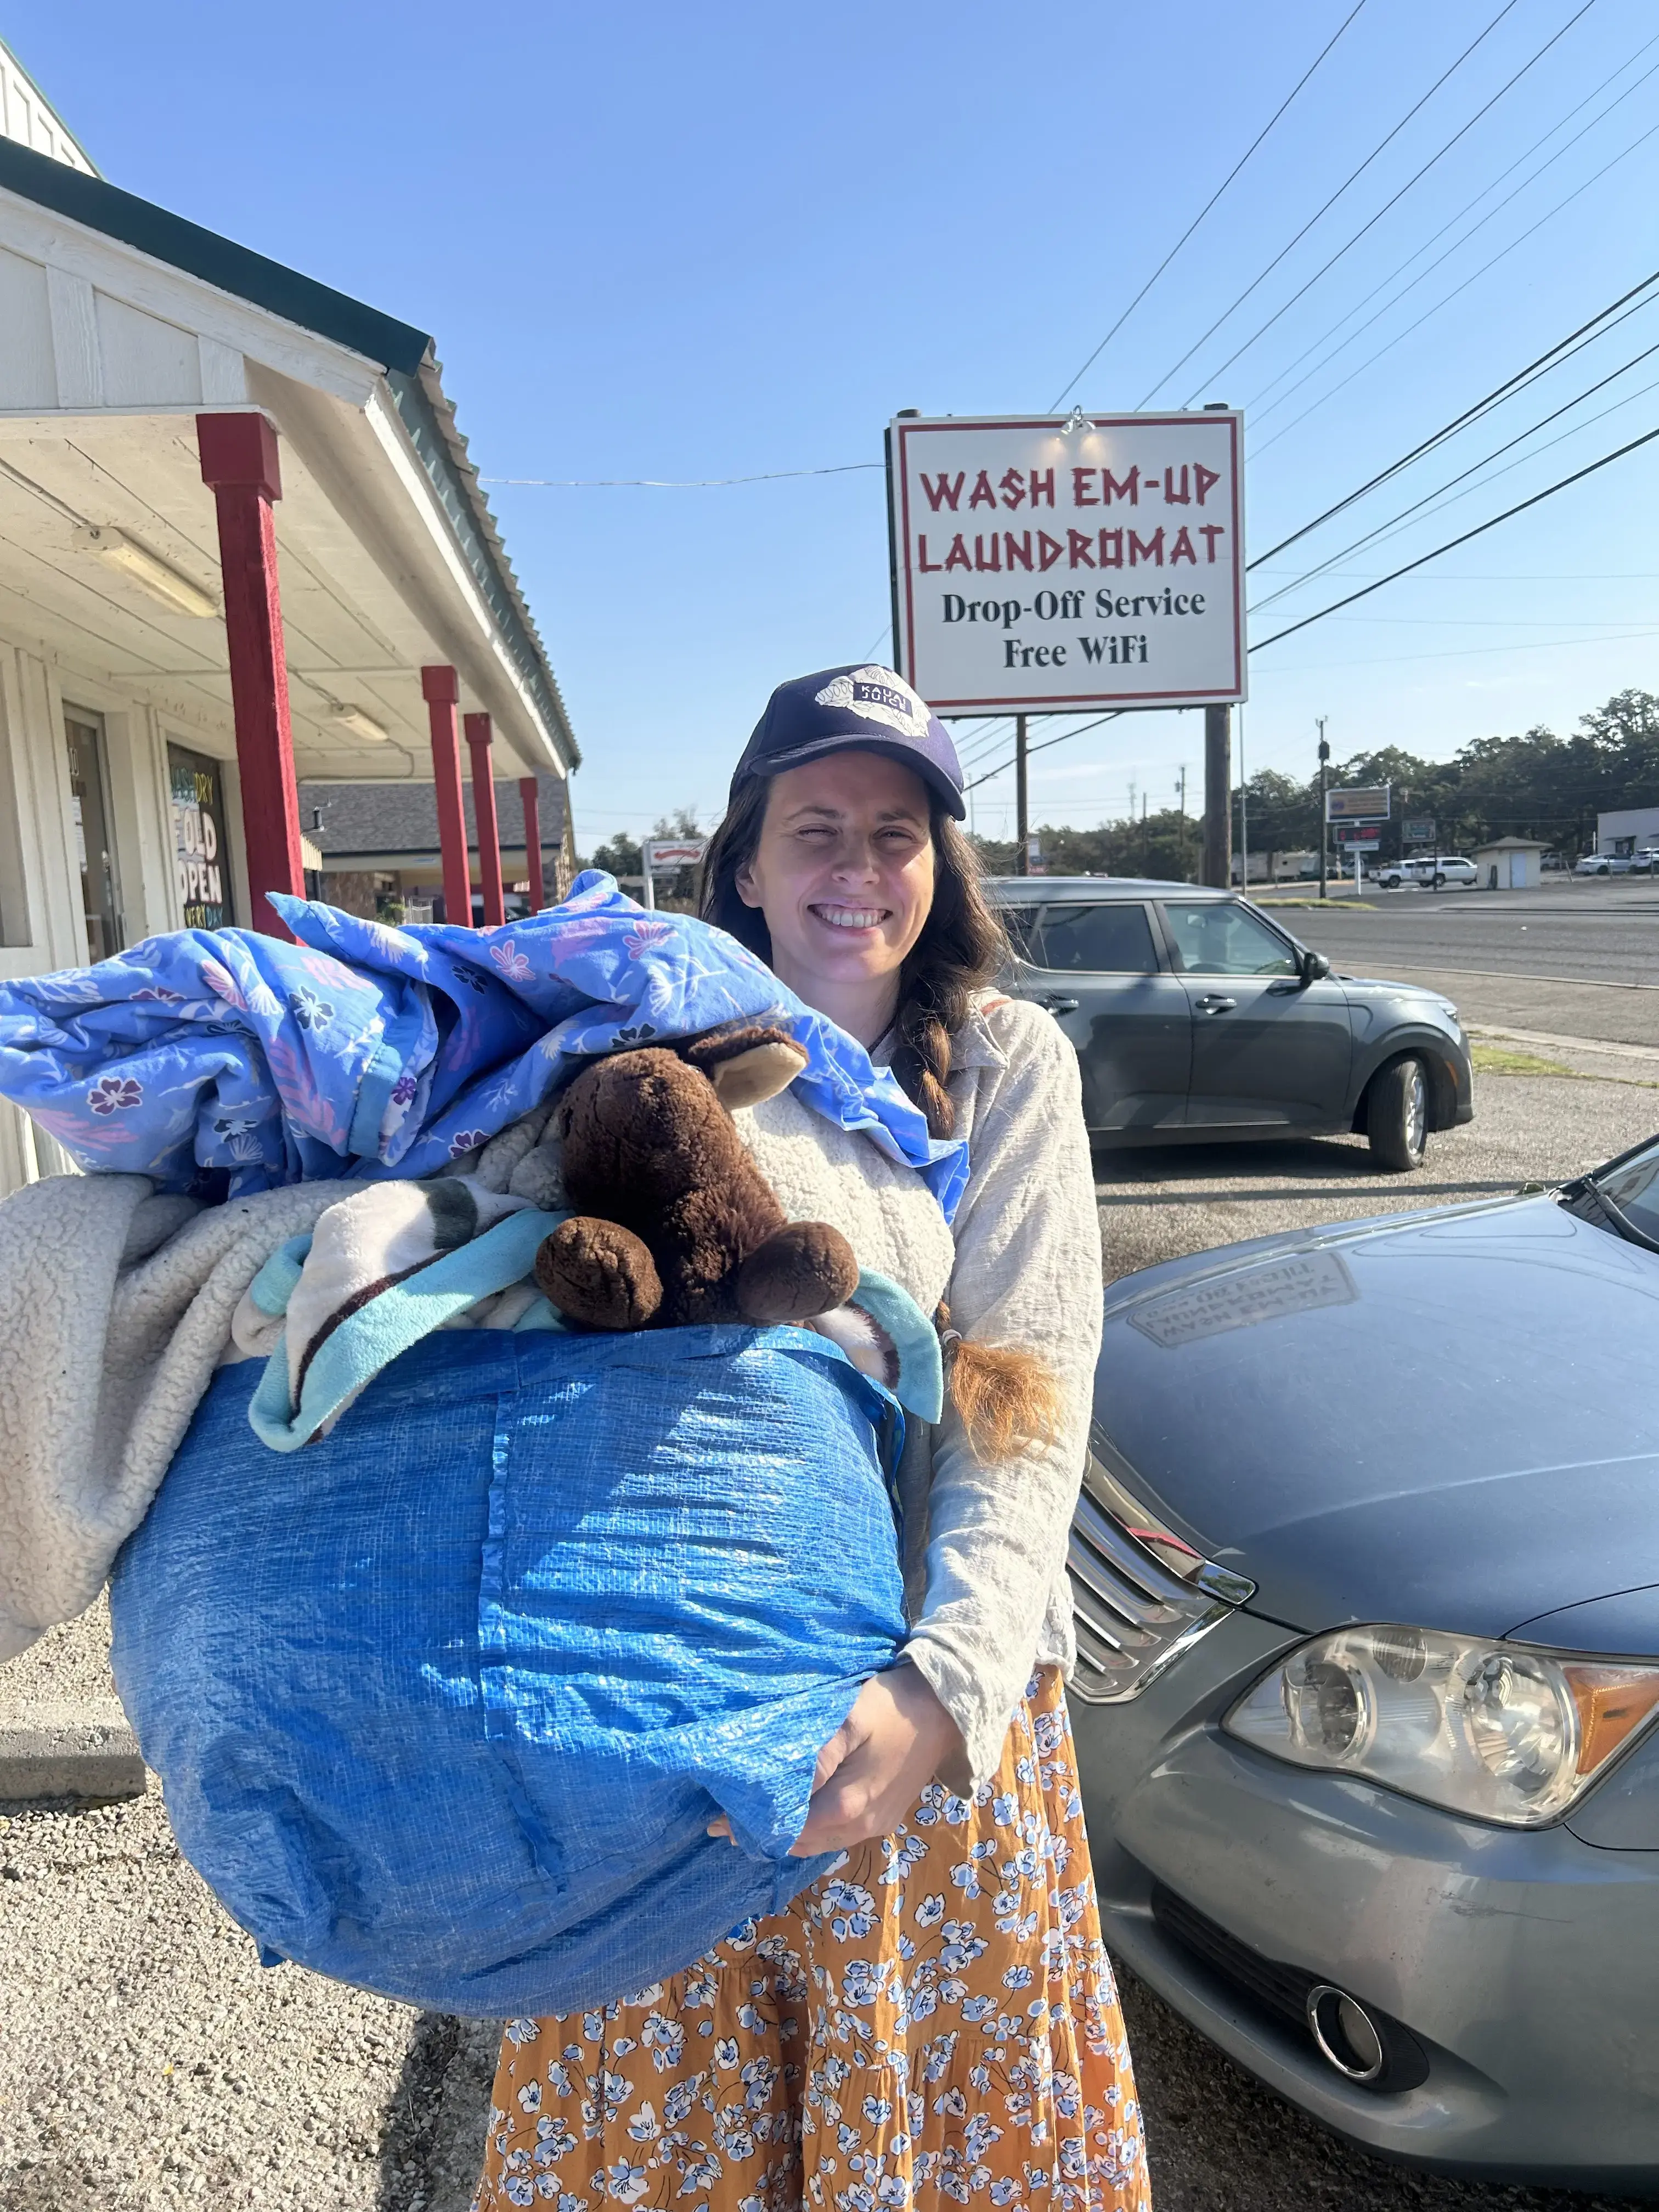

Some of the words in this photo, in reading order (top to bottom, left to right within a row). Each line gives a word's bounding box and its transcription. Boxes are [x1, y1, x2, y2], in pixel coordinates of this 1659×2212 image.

[919, 467, 1055, 511] WASH
[1071, 462, 1221, 506] EM-UP
[918, 523, 1226, 573] LAUNDROMAT
[941, 589, 1086, 629] Drop-Off
[1095, 587, 1206, 619] Service
[1002, 639, 1066, 668] Free
[1077, 634, 1149, 665] WiFi
[861, 685, 906, 706] KAUAI
[861, 692, 906, 712] JUICE
[195, 771, 213, 806] DRY
[176, 858, 223, 904] OPEN
[184, 904, 206, 929] VERY
